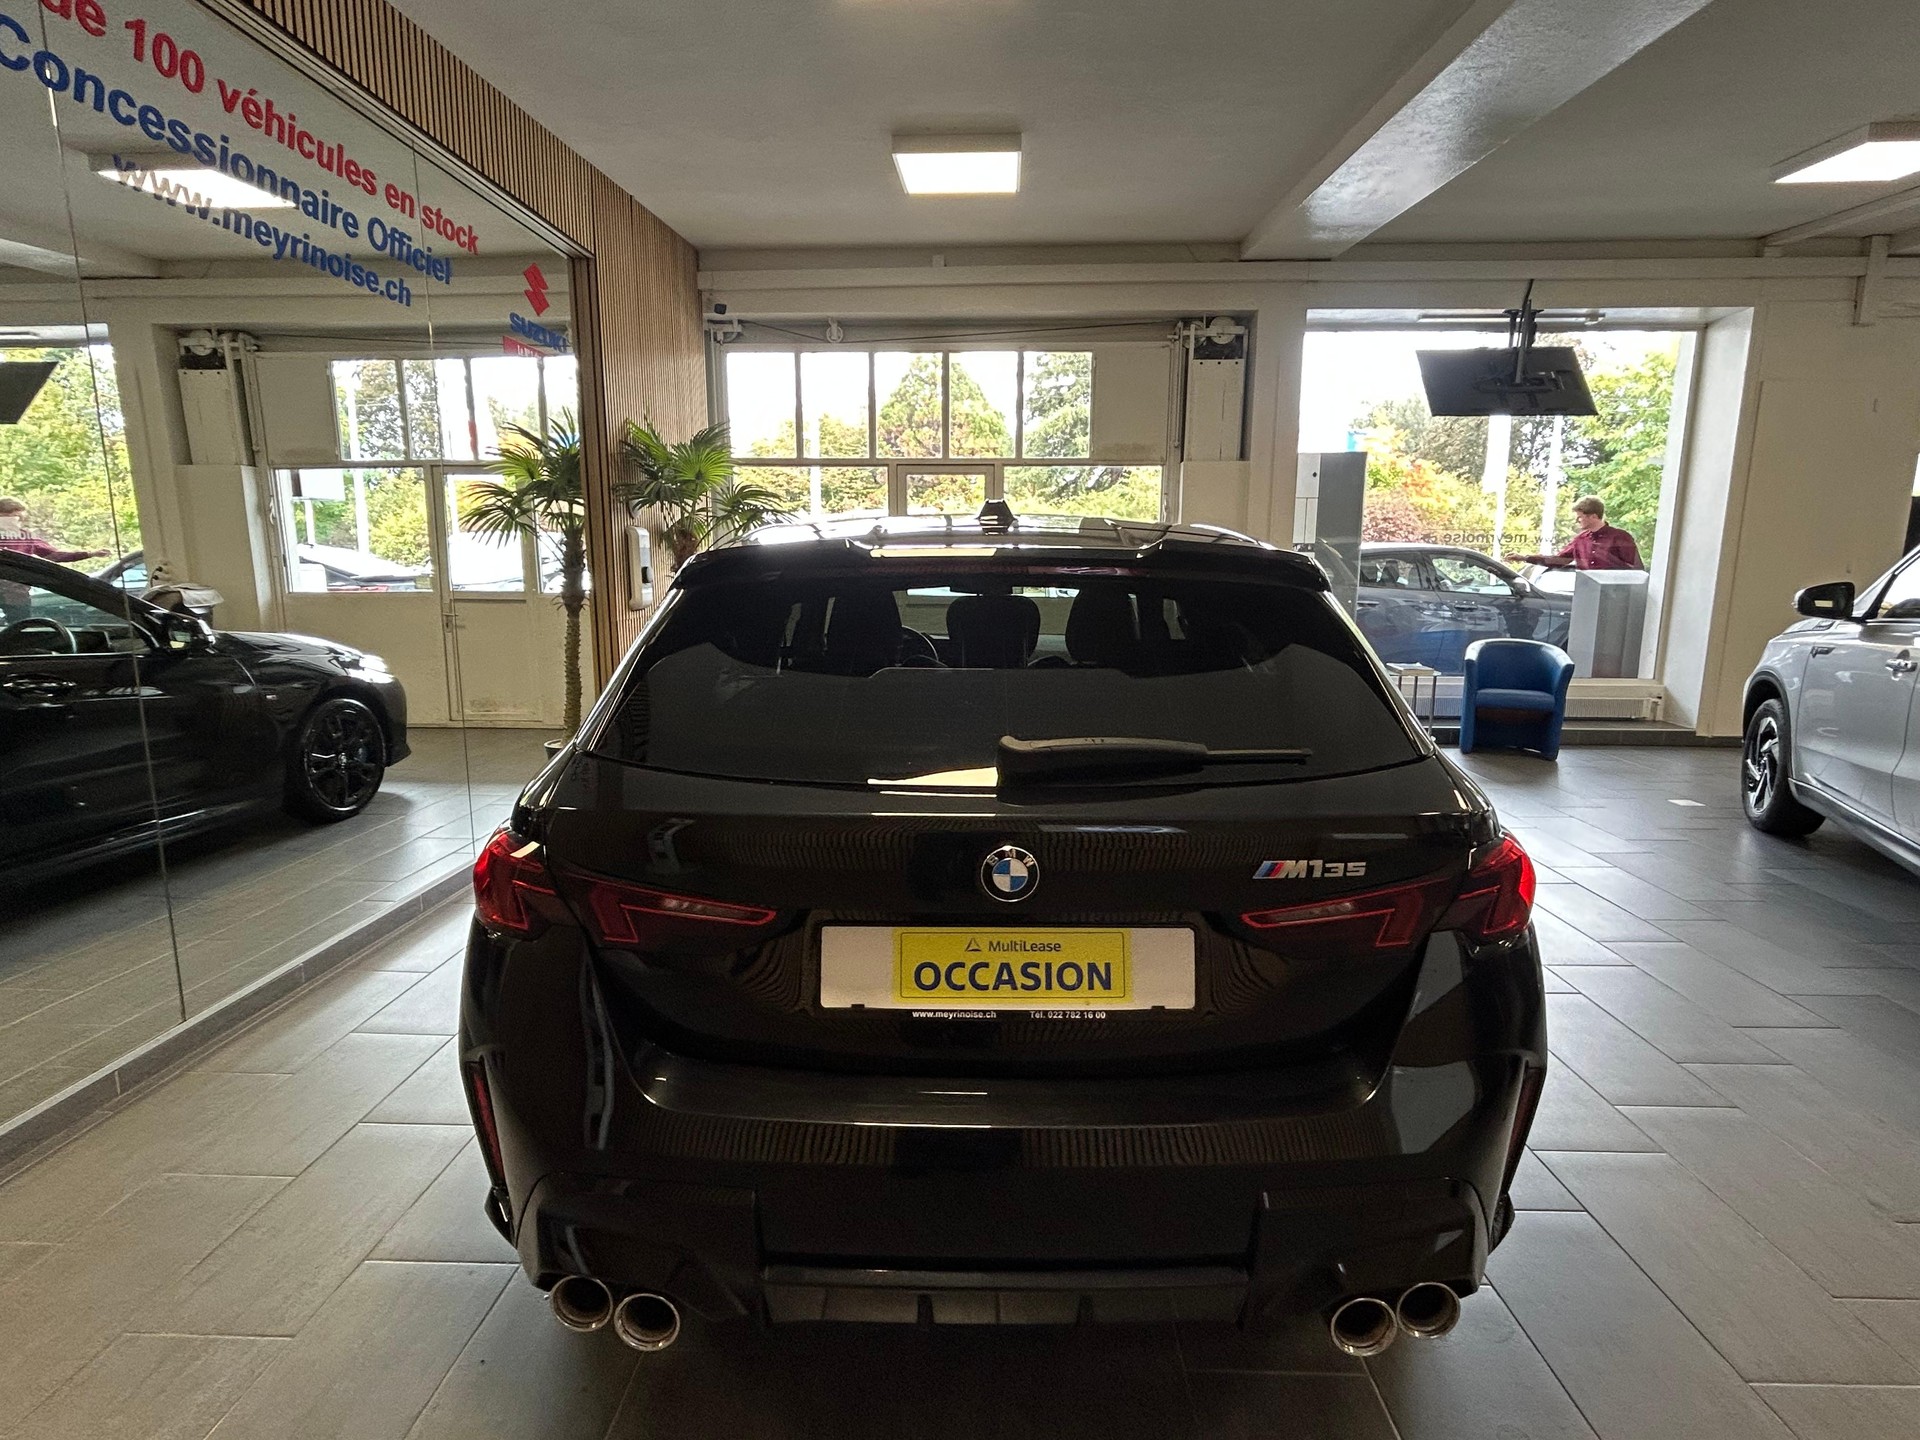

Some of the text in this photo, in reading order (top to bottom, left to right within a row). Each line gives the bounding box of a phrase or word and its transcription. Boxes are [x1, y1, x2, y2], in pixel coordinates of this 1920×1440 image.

[124, 18, 205, 93] 100
[216, 78, 377, 195] véhicules
[384, 183, 415, 218] en
[421, 204, 479, 255] stock
[0, 13, 453, 284] Concessionnaire Officiel
[112, 152, 412, 307] www.meyrinoise.ch
[986, 848, 1036, 868] BMW
[1275, 860, 1367, 879] M135
[988, 940, 1062, 952] MultiLease
[913, 961, 1112, 992] OCCASION
[912, 1010, 997, 1020] www.meyrinoise.ch
[1047, 1010, 1064, 1019] 022
[1065, 1010, 1082, 1019] 782
[1083, 1010, 1094, 1019] 16
[1095, 1010, 1106, 1019] 00
